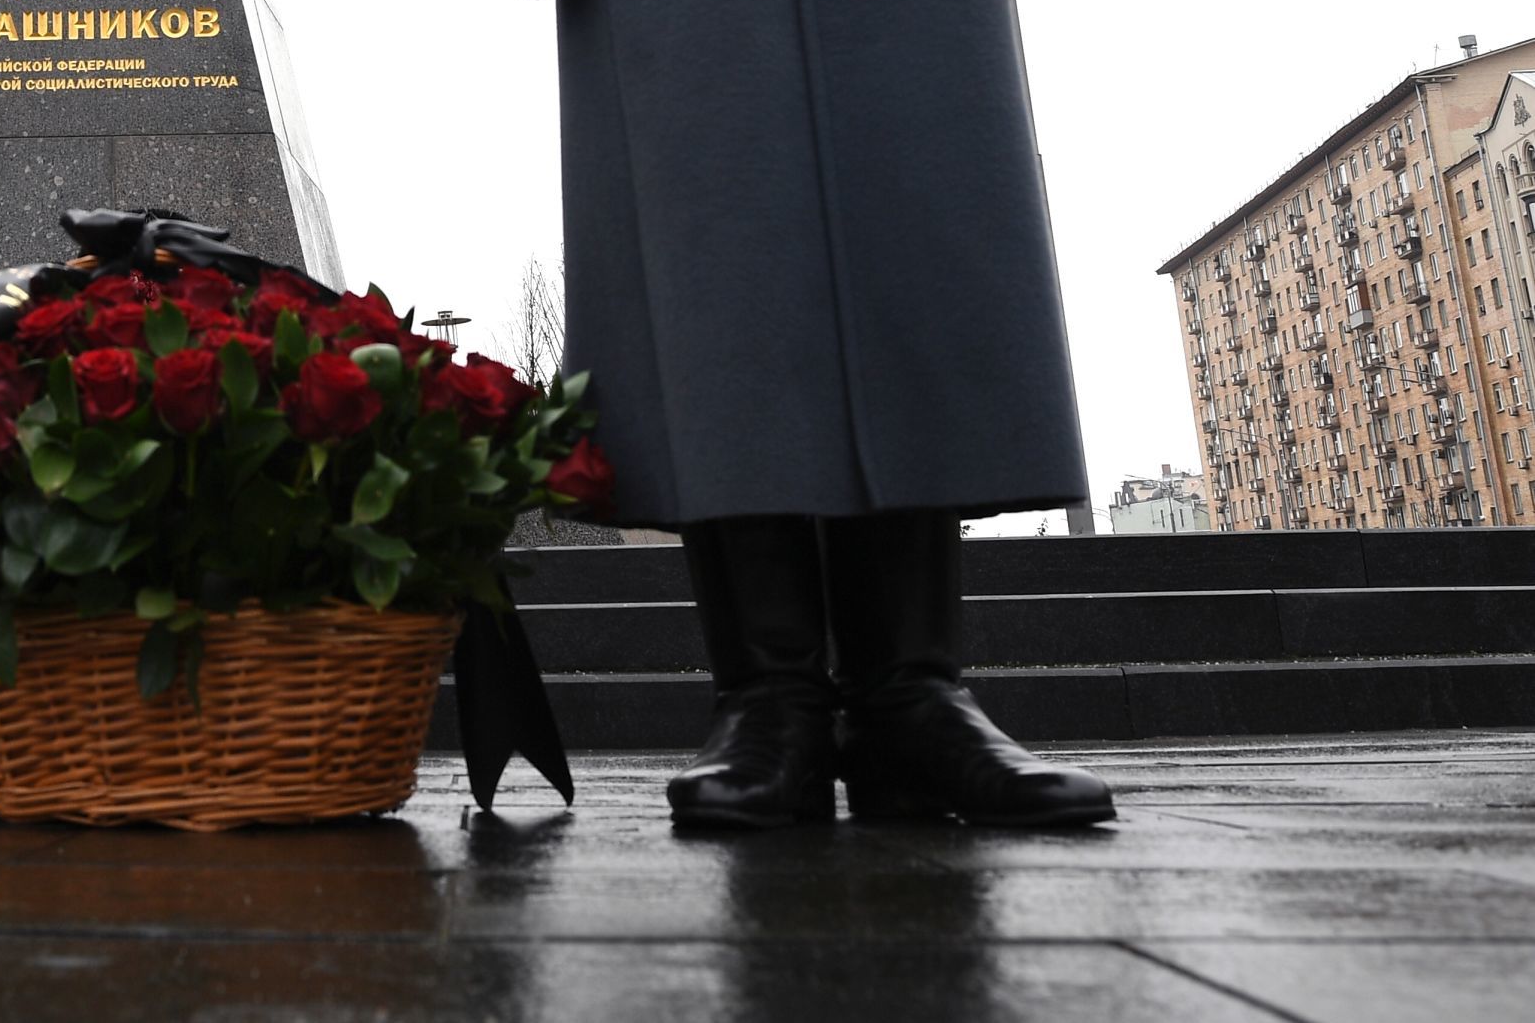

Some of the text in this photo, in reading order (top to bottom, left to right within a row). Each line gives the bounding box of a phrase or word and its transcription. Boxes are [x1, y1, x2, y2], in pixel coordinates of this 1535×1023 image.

[56, 58, 146, 73] ФЕДЕРАЦИИ
[25, 76, 190, 92] СОЦИАЛИСТИЧЕСКОГО
[193, 75, 239, 89] ТРУДА
